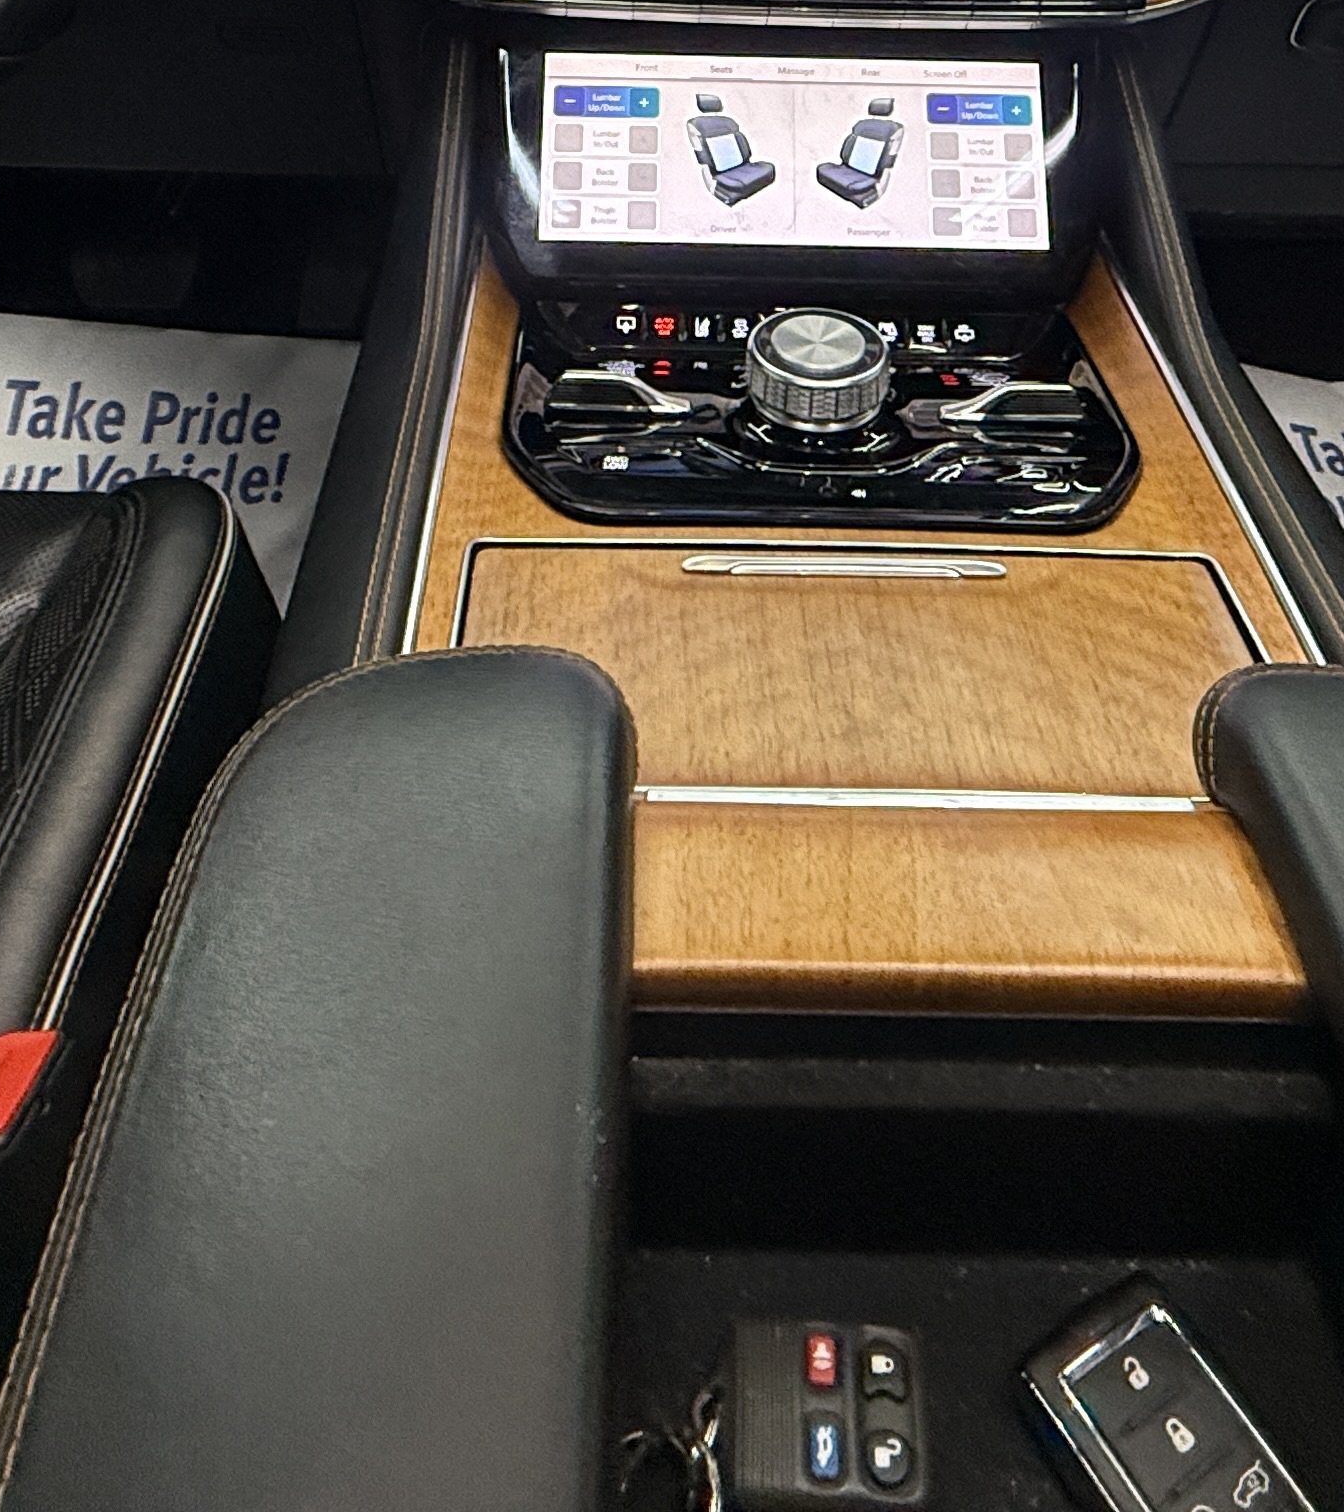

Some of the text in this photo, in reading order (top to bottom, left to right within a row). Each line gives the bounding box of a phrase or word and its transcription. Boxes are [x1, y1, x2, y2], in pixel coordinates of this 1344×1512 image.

[634, 63, 658, 72] Front
[709, 65, 734, 74] Seats
[860, 68, 880, 77] Rear
[923, 69, 953, 79] Screen
[954, 69, 968, 79] Off
[592, 93, 622, 102] Lumbar
[587, 103, 626, 113] Up/Down
[964, 101, 994, 110] Lumbar
[961, 111, 999, 120] Up/Down
[709, 225, 737, 234] Driver
[847, 227, 891, 237] Passenger
[4, 380, 126, 443] Take
[141, 391, 282, 445] Pride
